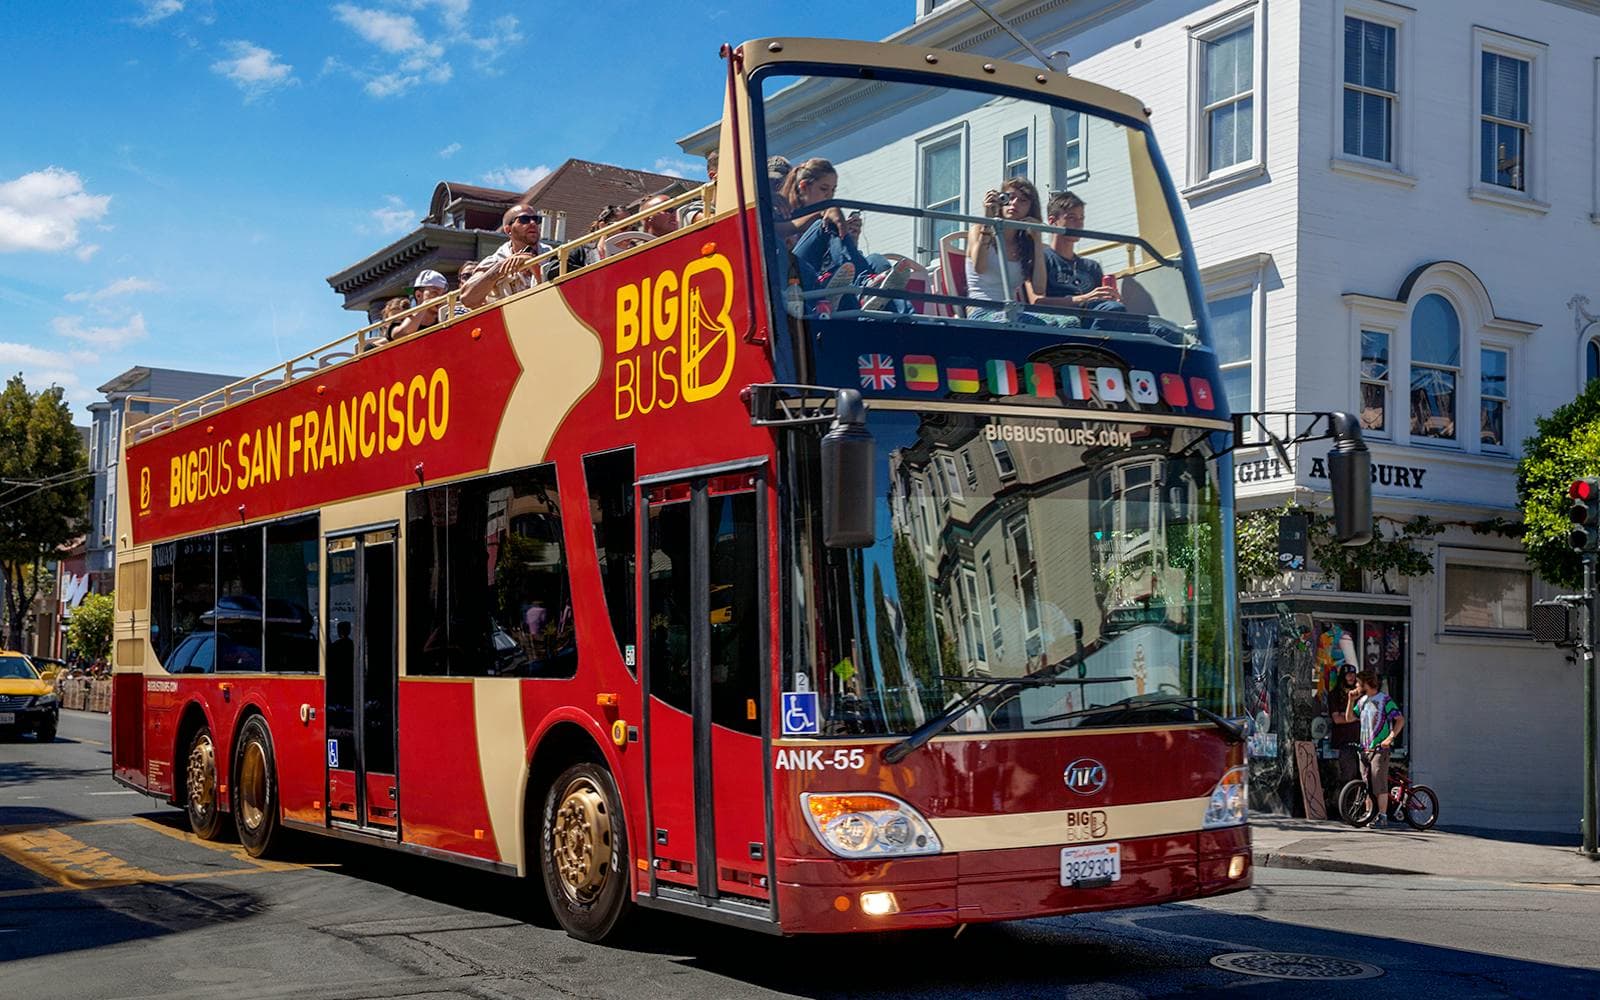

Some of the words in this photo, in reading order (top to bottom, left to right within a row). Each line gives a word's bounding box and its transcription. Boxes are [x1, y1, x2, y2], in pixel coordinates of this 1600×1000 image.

[616, 270, 679, 354] BIG
[616, 346, 679, 420] BUS
[237, 422, 282, 490] SAN
[289, 367, 450, 477] FRANCISCO
[985, 424, 1132, 447] BIGBUSTOURS.COM
[1309, 457, 1427, 489] ABURY
[775, 748, 865, 771] ANK-55
[1067, 811, 1090, 827] BIG
[1067, 827, 1090, 841] BUS
[1066, 858, 1116, 880] 38293C1
